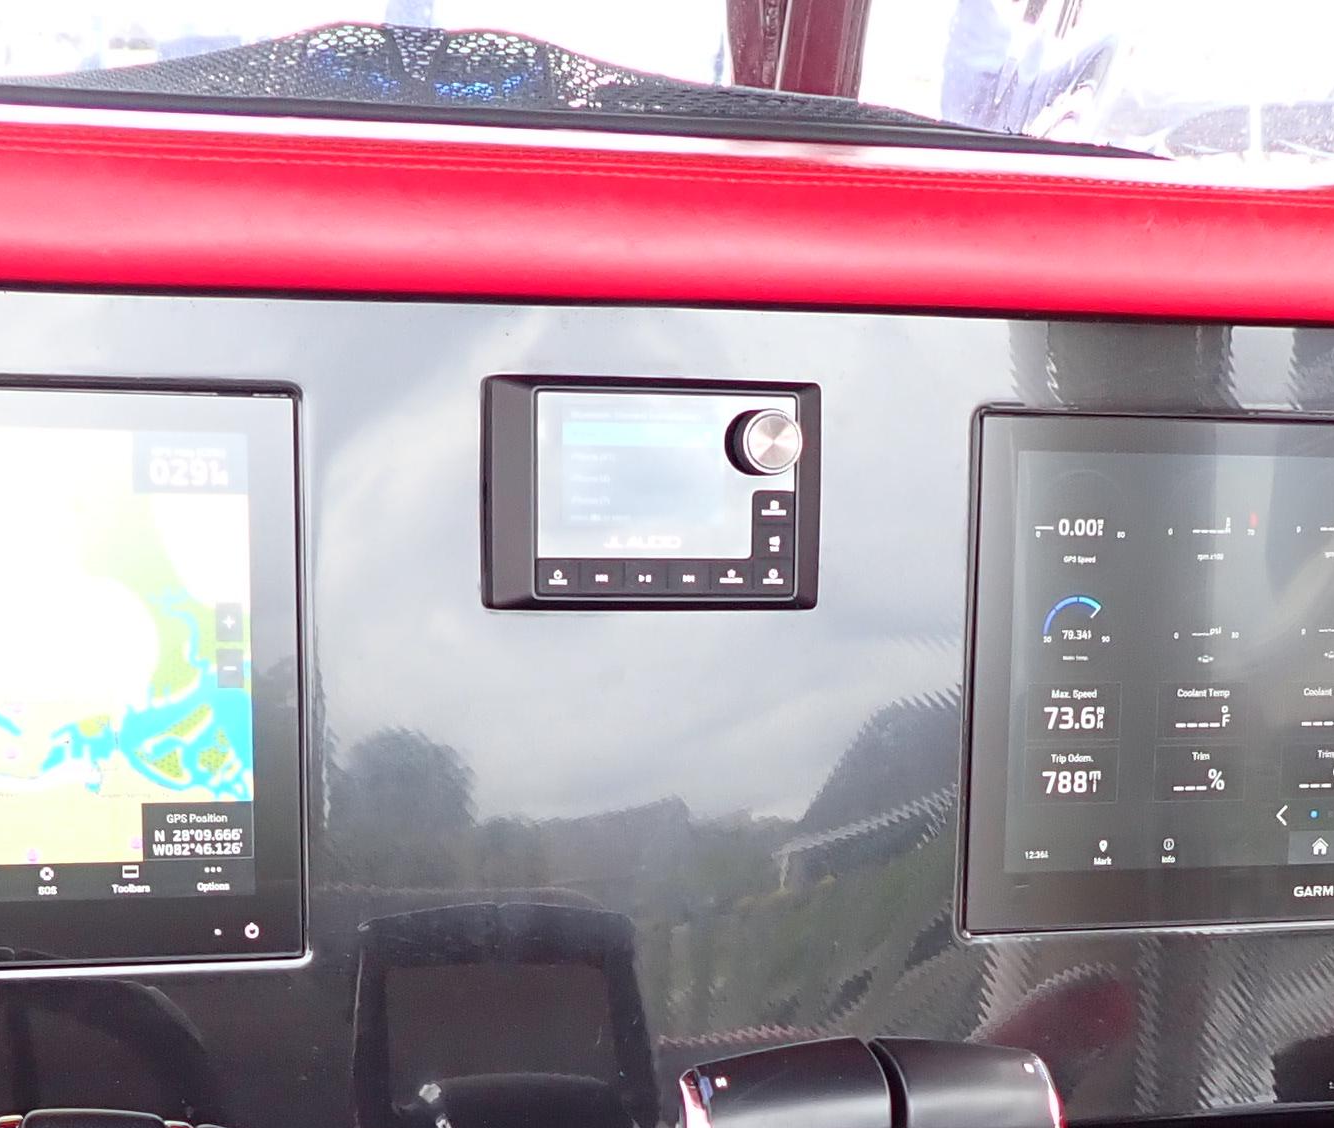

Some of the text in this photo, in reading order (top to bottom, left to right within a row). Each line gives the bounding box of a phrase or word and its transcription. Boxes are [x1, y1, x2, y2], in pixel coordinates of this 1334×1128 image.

[1058, 518, 1097, 536] 0.00
[1073, 689, 1097, 700] Speed
[1177, 688, 1231, 699] Coolant Temp
[1303, 687, 1332, 697] Coolant
[1044, 706, 1095, 729] 73.6
[1051, 754, 1066, 764] Trip
[1192, 752, 1210, 761] Trim
[1318, 750, 1334, 759] Trim
[1042, 770, 1088, 794] 788
[166, 813, 228, 825] GPS Position
[154, 830, 166, 842] N
[1093, 856, 1112, 866] Mark
[1161, 855, 1175, 864] Info
[38, 886, 58, 895] SOS
[111, 884, 151, 894] Toolbars
[196, 882, 230, 893] Options
